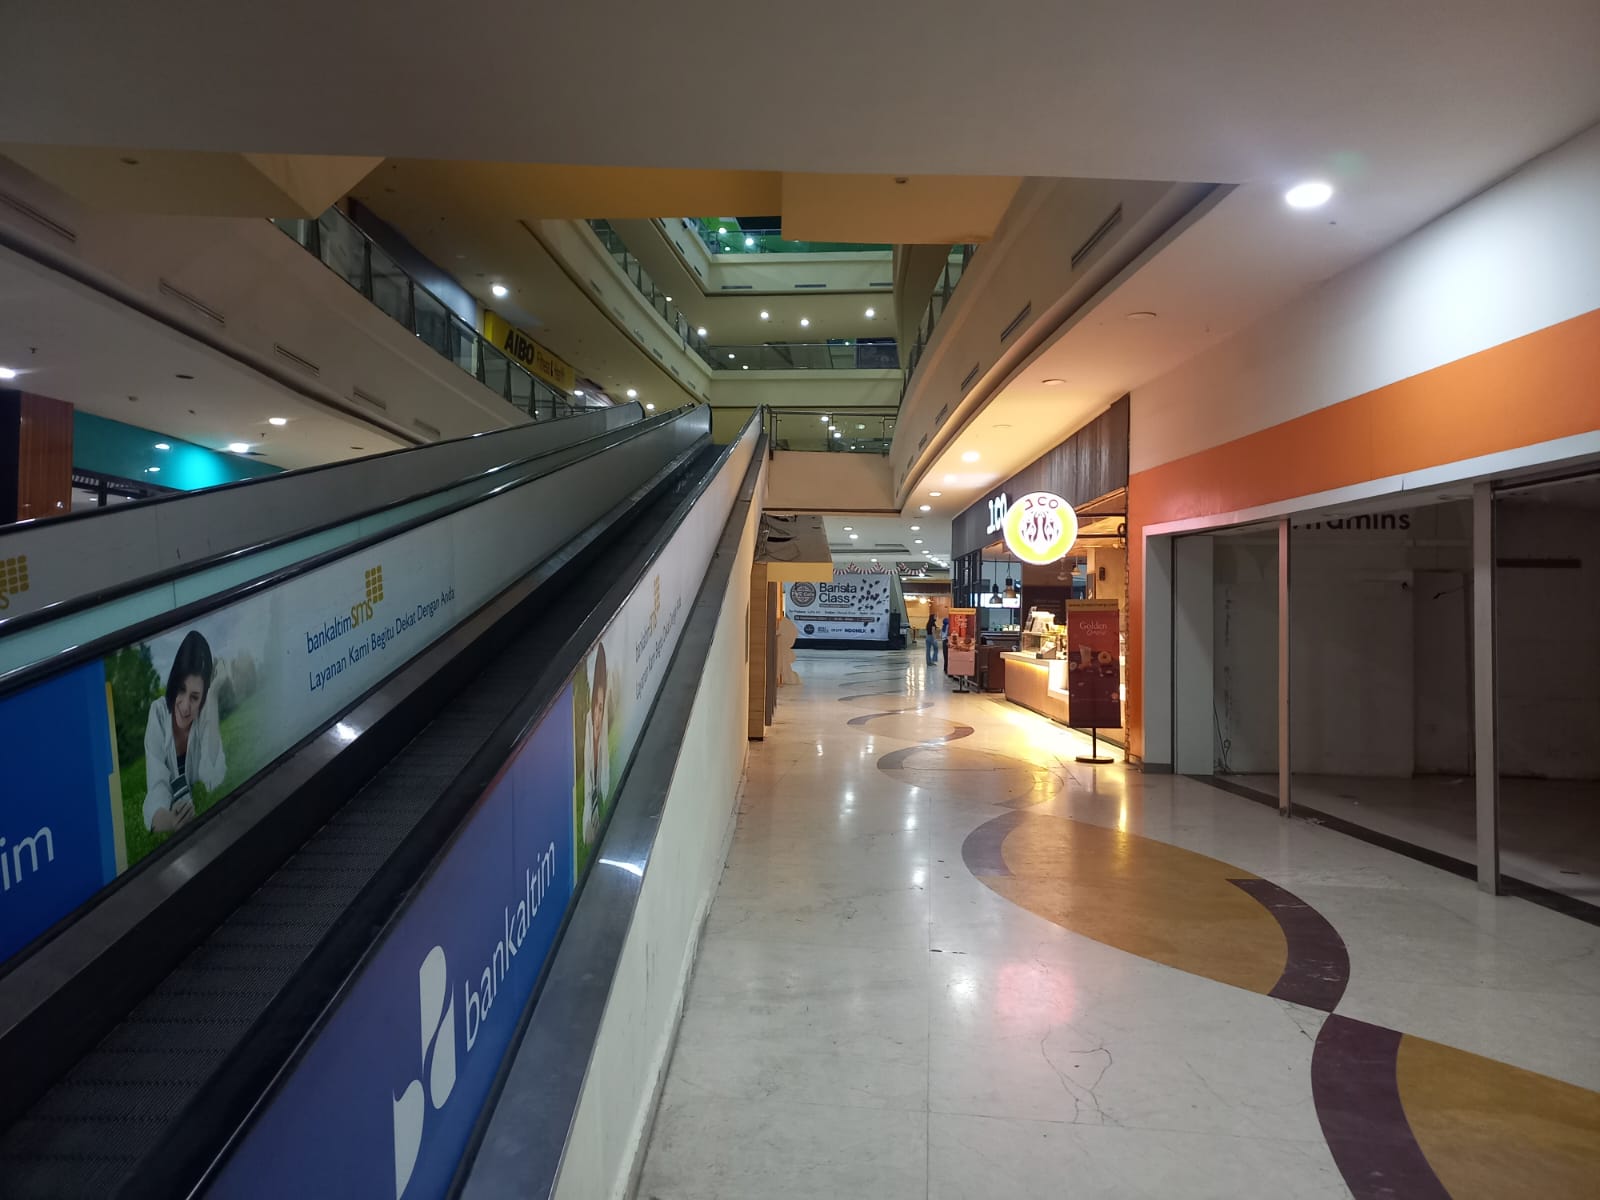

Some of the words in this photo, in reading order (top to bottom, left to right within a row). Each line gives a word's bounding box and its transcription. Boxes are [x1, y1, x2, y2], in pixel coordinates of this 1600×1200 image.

[1292, 513, 1411, 530] amins
[820, 582, 857, 594] Barista
[819, 593, 851, 603] Class
[1080, 620, 1108, 631] Golden
[309, 657, 347, 692] Layanan
[349, 638, 370, 667] Kami
[371, 627, 395, 650] Begitu
[396, 612, 417, 634] Dekat
[417, 598, 440, 622] Dengan
[441, 586, 455, 606] Anda
[465, 841, 556, 1053] bankaltim
